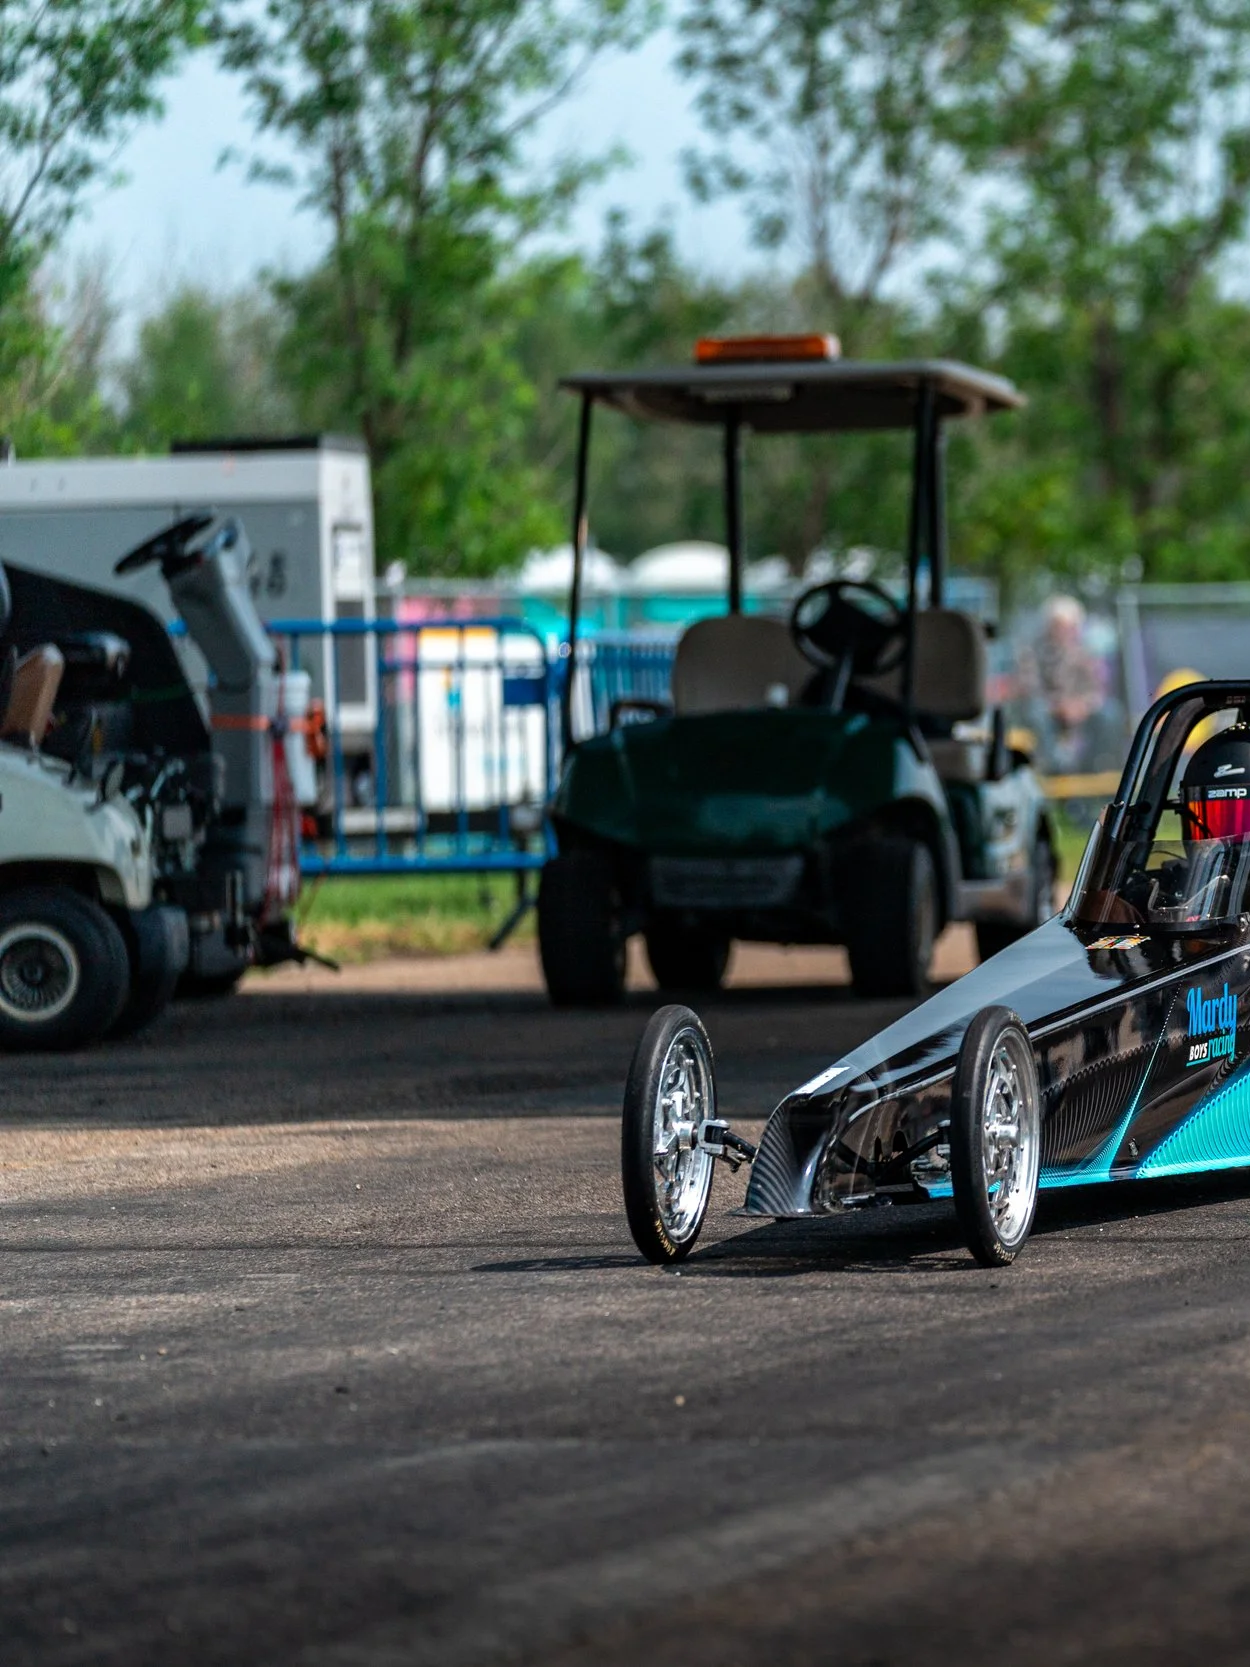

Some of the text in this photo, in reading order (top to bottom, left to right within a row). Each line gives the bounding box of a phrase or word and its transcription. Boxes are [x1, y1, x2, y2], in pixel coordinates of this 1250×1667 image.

[1207, 787, 1248, 799] zamp
[1186, 982, 1238, 1060] Mardy
[1188, 1042, 1208, 1061] BOYS
